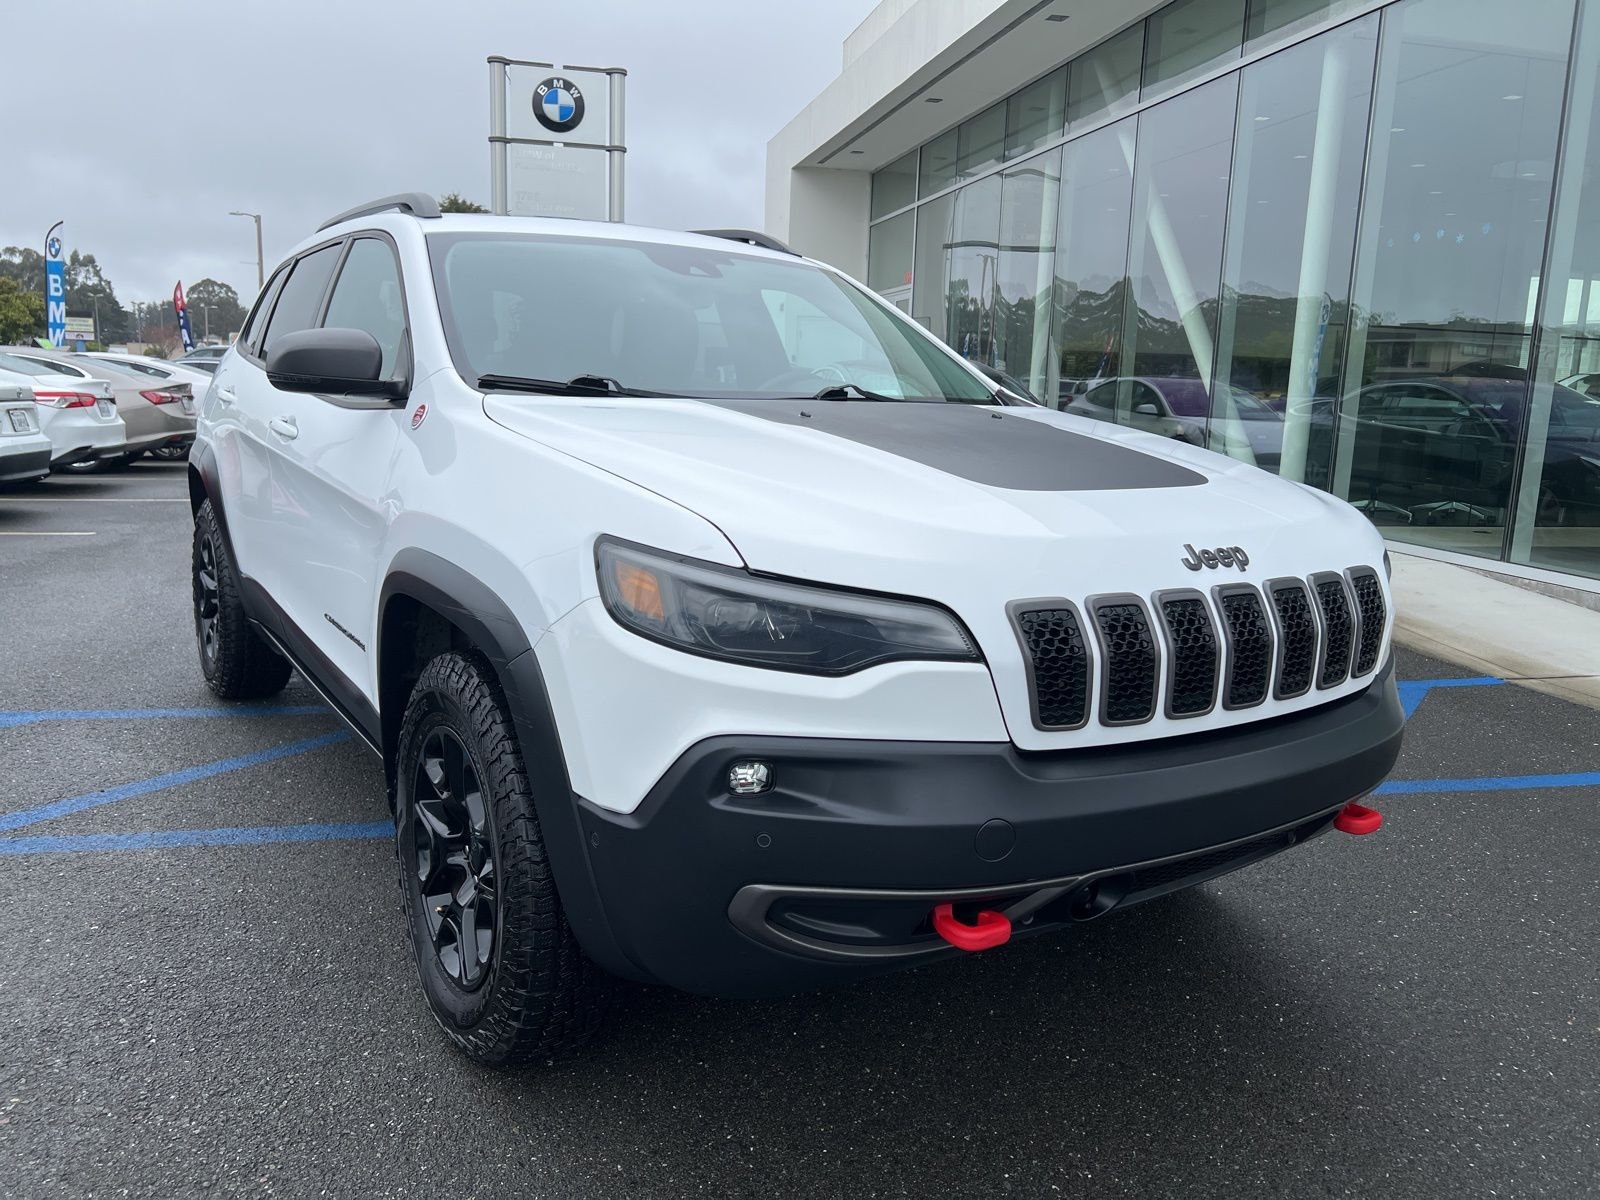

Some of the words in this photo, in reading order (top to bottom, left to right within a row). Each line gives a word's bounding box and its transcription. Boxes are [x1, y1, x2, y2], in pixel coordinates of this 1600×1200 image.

[537, 79, 580, 98] BMW
[49, 274, 65, 346] BMW
[1181, 543, 1249, 572] Jeep
